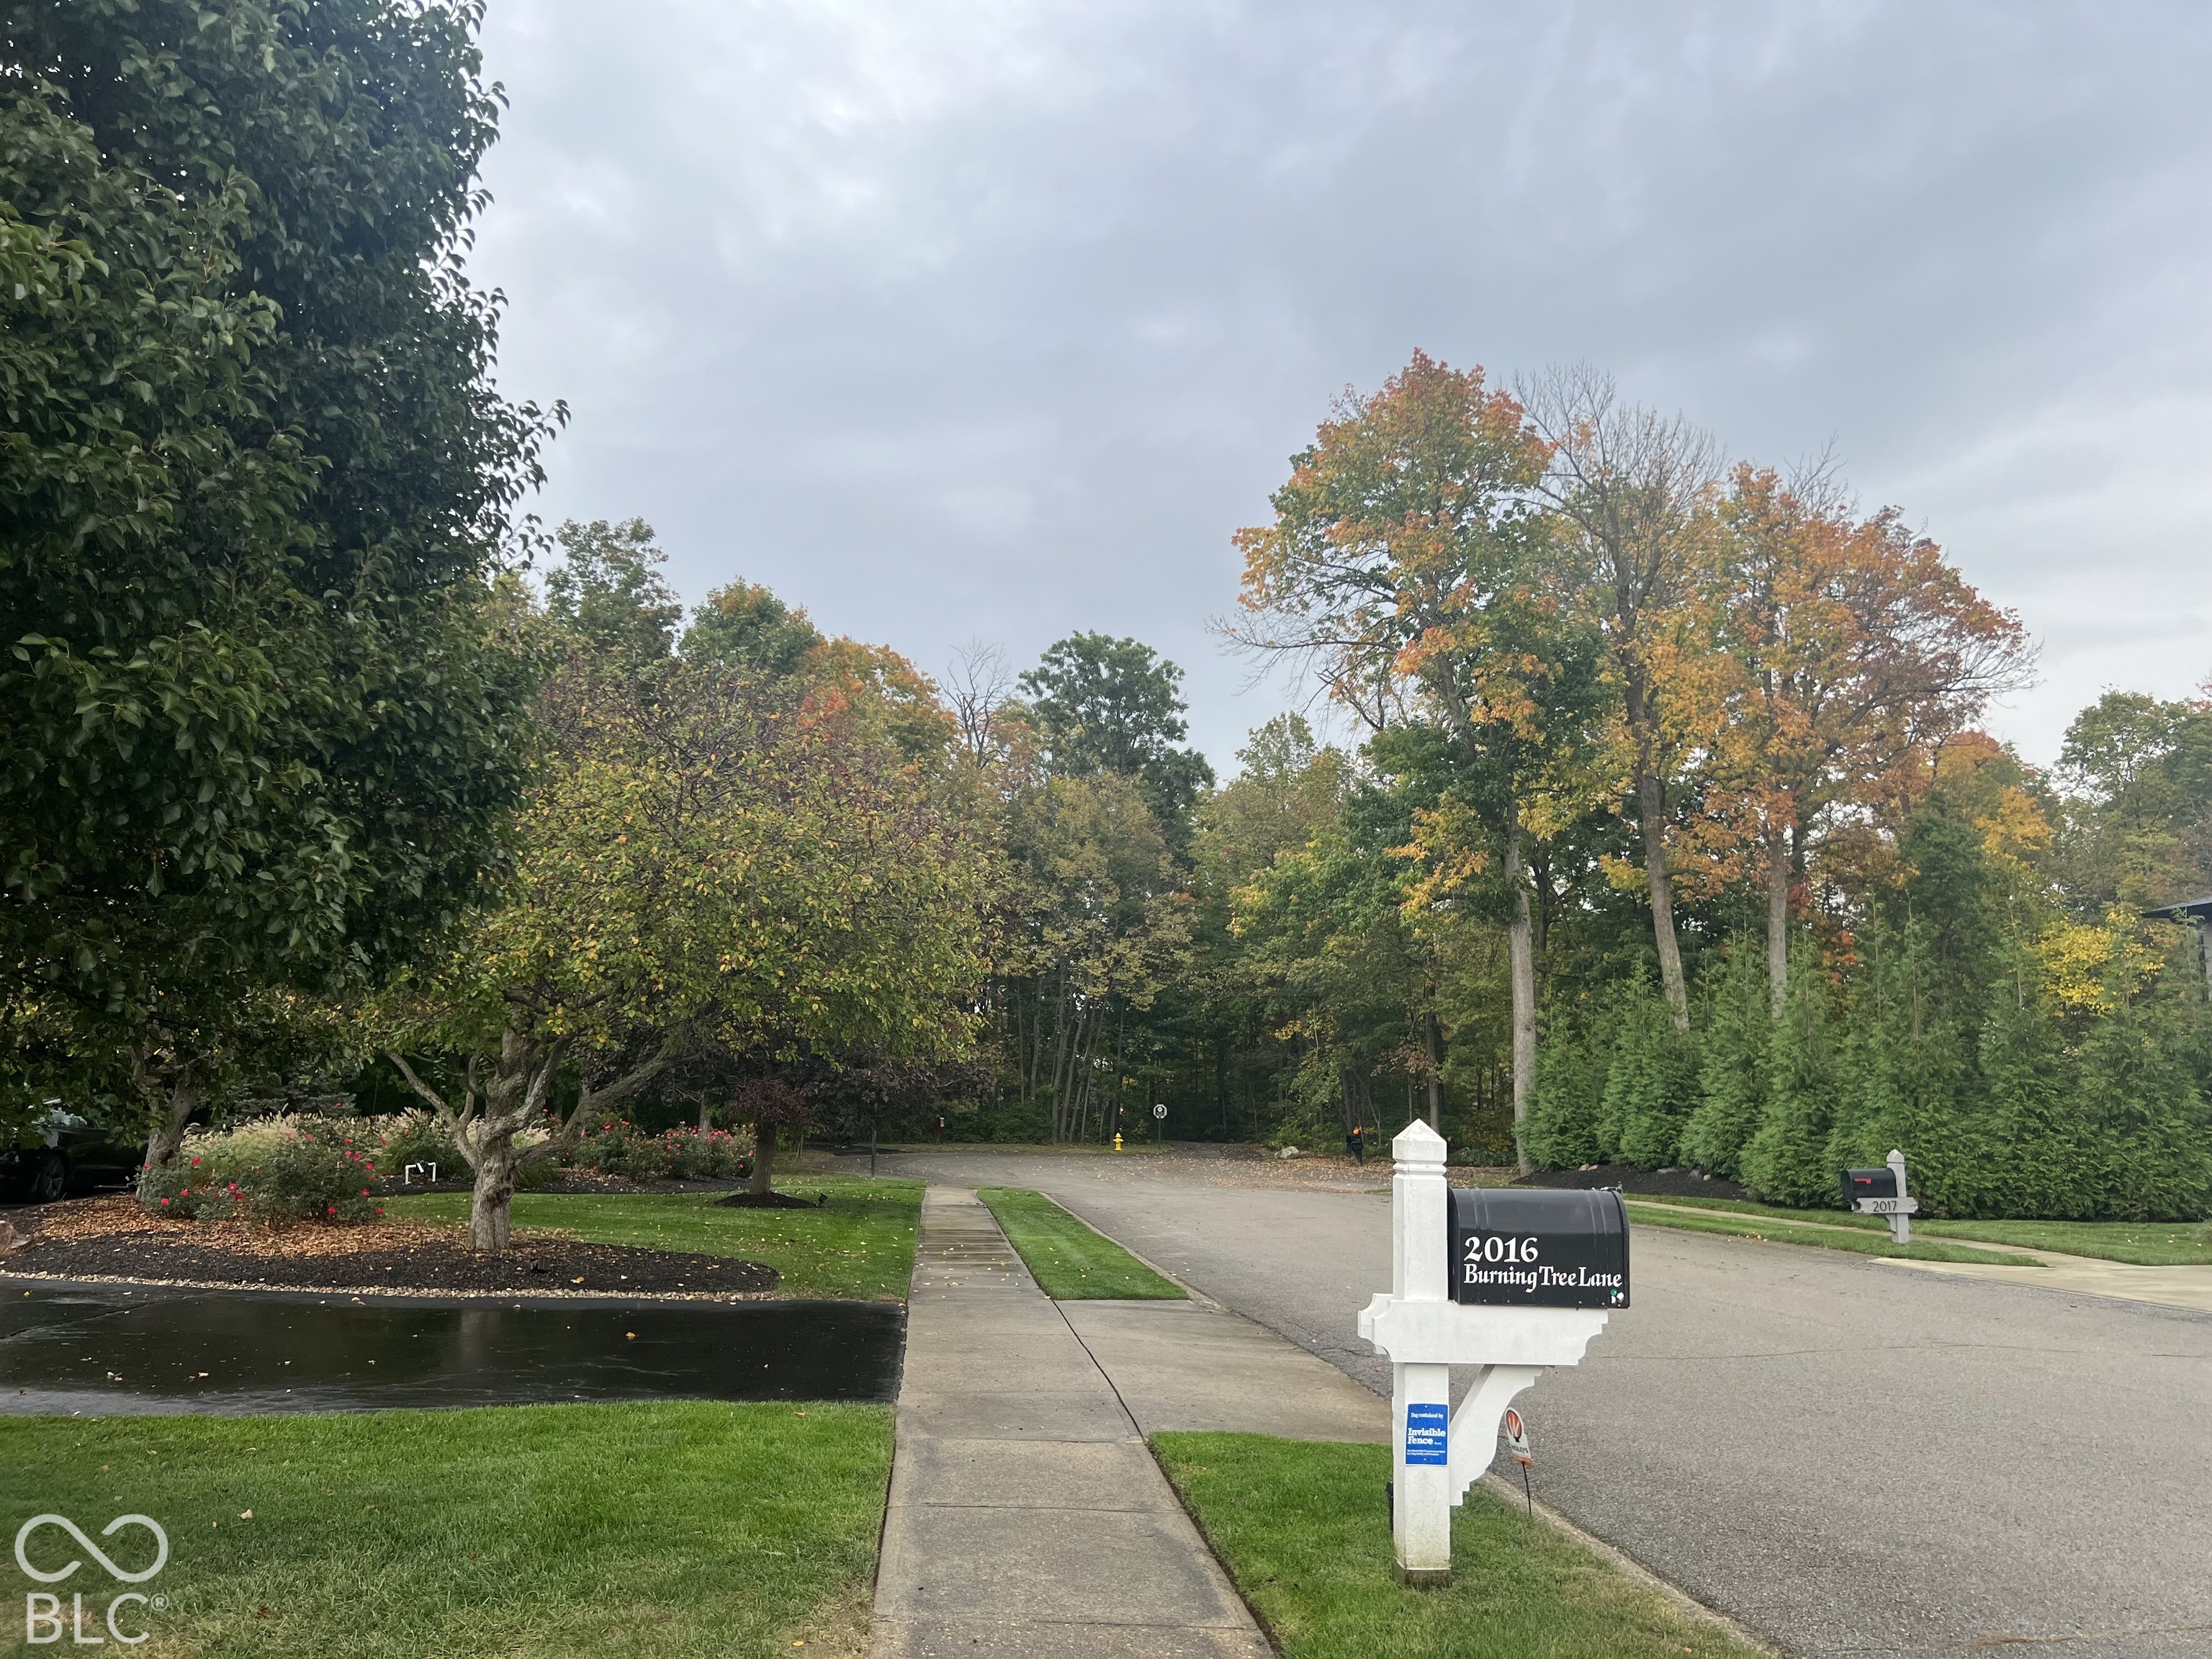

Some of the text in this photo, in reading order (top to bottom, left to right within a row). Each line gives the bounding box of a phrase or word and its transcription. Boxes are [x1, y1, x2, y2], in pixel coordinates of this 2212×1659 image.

[1872, 1200, 1897, 1212] 2017
[1464, 1236, 1539, 1262] 2016
[1464, 1263, 1622, 1293] Burning Tree Lane
[1408, 1427, 1446, 1437] Invisible
[1407, 1436, 1434, 1444] Fence
